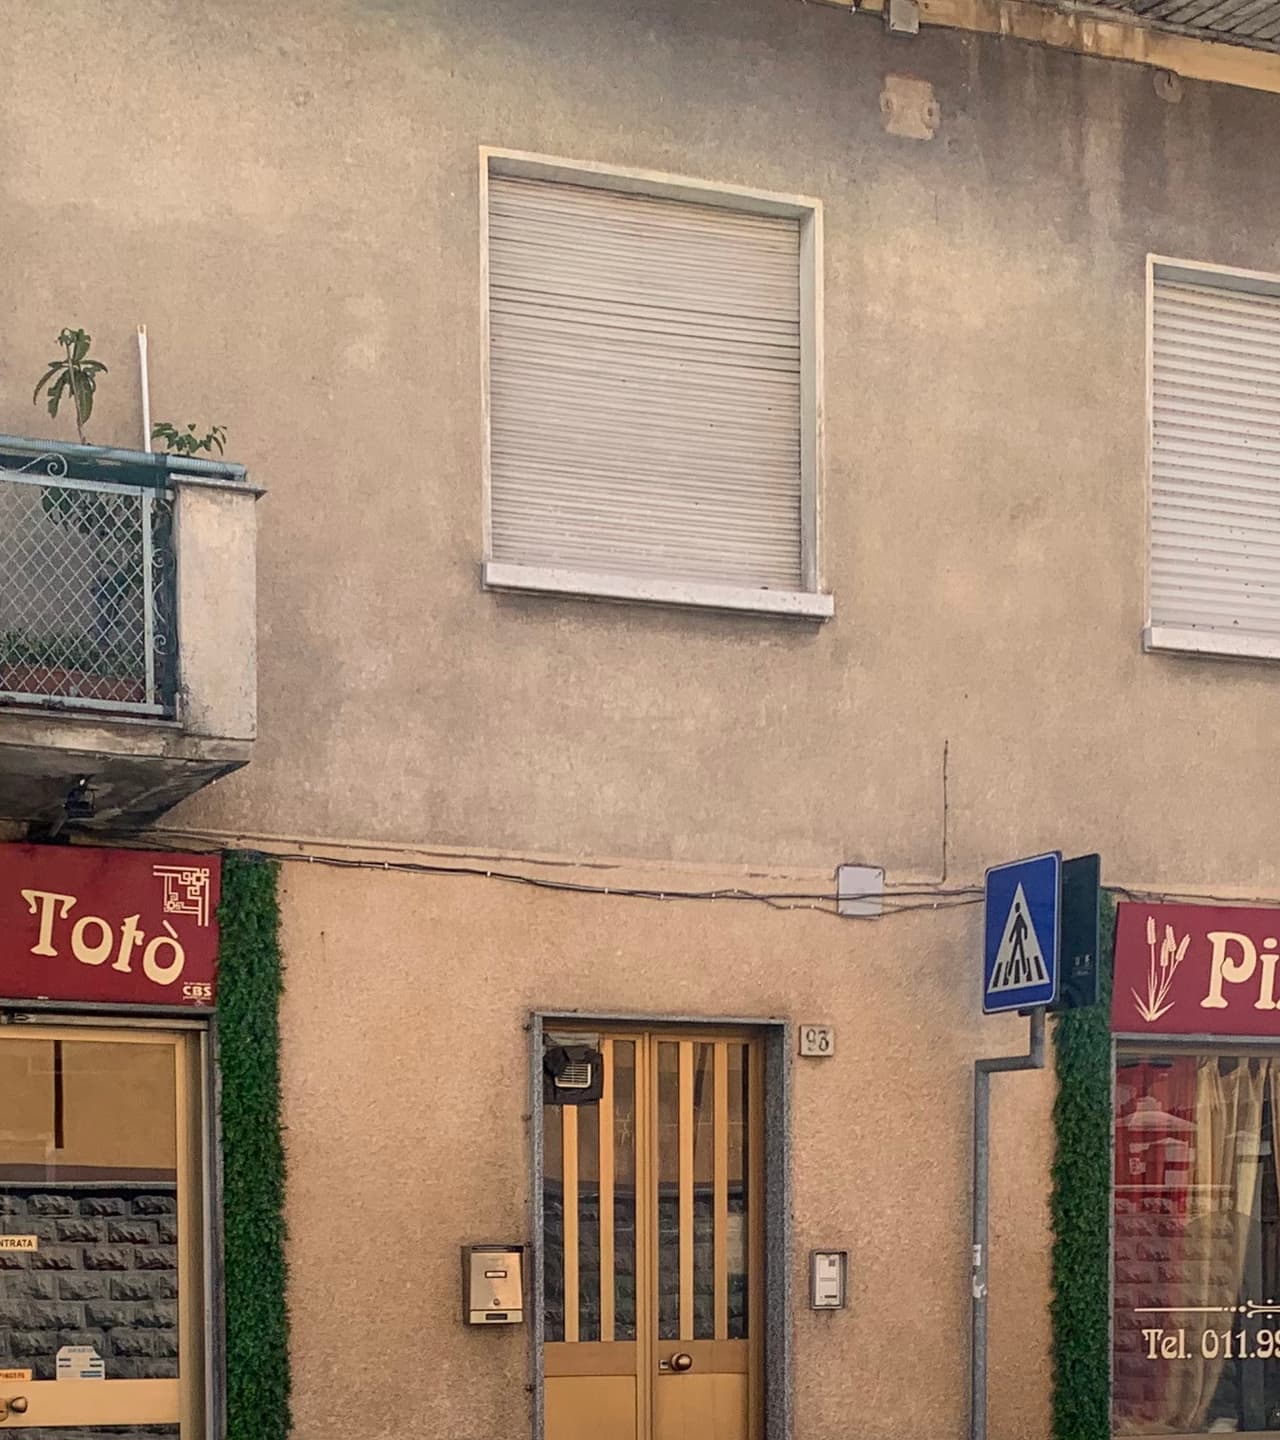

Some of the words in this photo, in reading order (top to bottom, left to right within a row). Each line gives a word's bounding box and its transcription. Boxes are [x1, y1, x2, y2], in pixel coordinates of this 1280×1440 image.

[21, 889, 185, 985] Totò
[182, 985, 212, 997] CBS
[1141, 1328, 1193, 1359] Tel.
